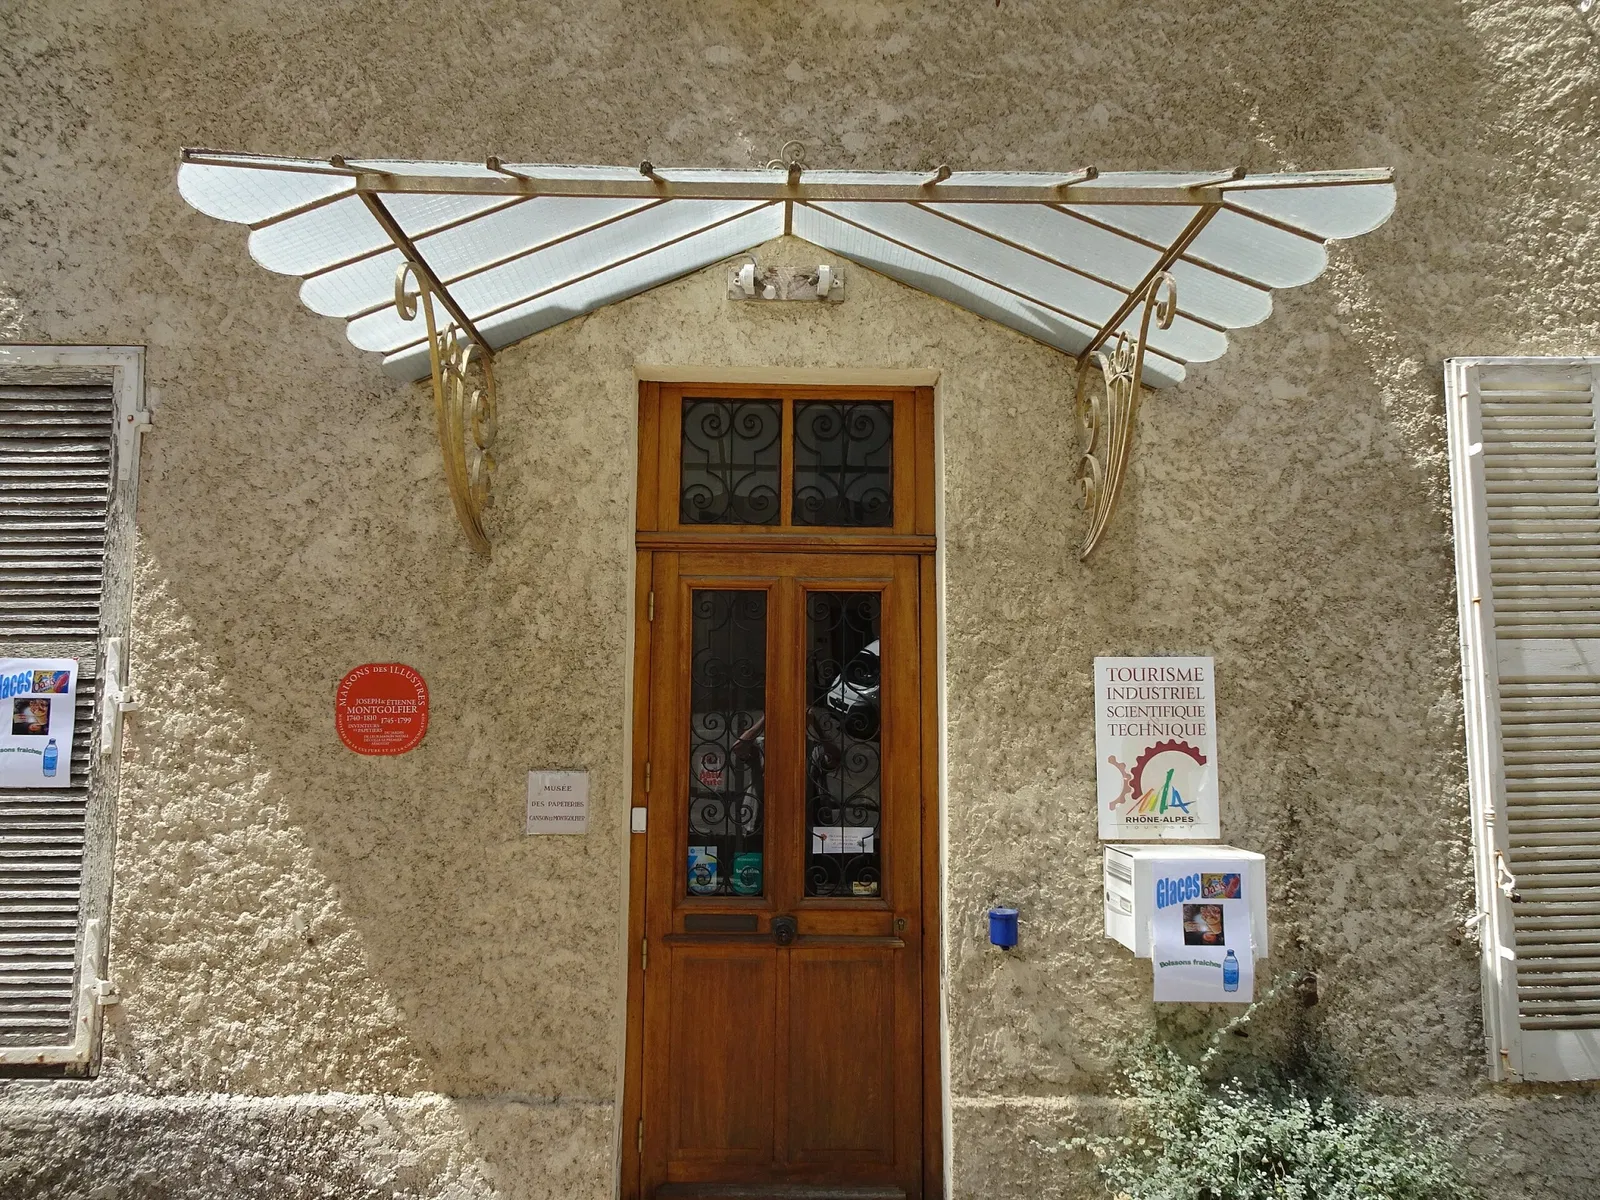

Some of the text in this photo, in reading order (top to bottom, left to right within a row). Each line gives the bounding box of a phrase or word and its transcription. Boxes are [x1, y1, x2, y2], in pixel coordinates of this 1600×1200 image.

[1106, 667, 1204, 681] TOURISME
[0, 669, 32, 699] laces
[339, 666, 370, 707] MAISONS
[390, 665, 426, 706] ILLUSTRES
[1107, 687, 1205, 700] INDUSTRIEL
[355, 698, 380, 706] JOSEPH
[386, 698, 417, 706] ÉTIENNE
[347, 705, 418, 714] MONTGOLFIER
[1107, 706, 1205, 720] SCIENTIFIQUE
[1107, 724, 1206, 738] TECHNIQUE
[1125, 814, 1195, 823] RHÔNE-ALPES
[1156, 873, 1200, 910] Glaces
[1159, 960, 1191, 969] Boissons
